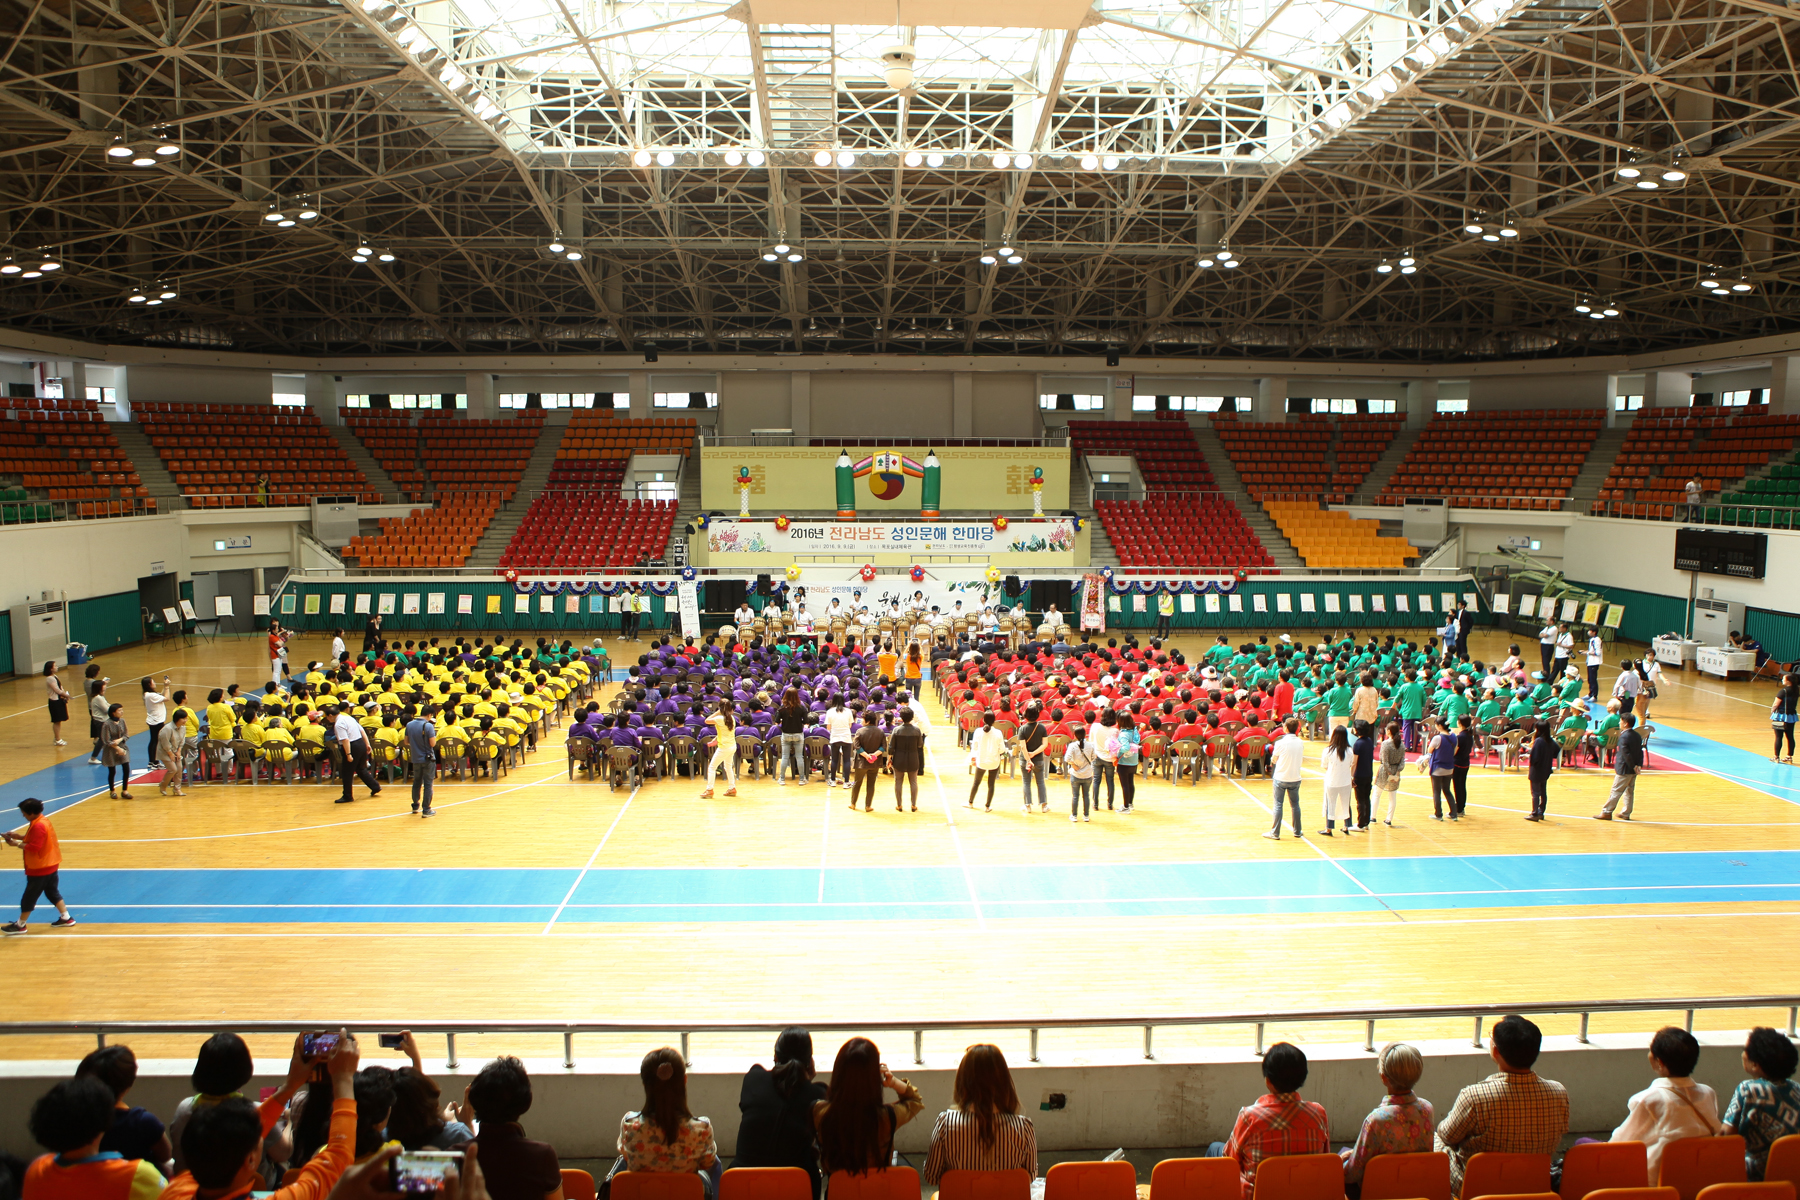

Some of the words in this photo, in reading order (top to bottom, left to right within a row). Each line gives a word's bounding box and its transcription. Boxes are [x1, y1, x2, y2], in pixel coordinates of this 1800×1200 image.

[791, 528, 823, 539] 2016년
[829, 527, 885, 540] 전라남도
[891, 527, 947, 541] 성인문해
[952, 527, 994, 541] 한마당
[1701, 656, 1723, 667] 의료지원
